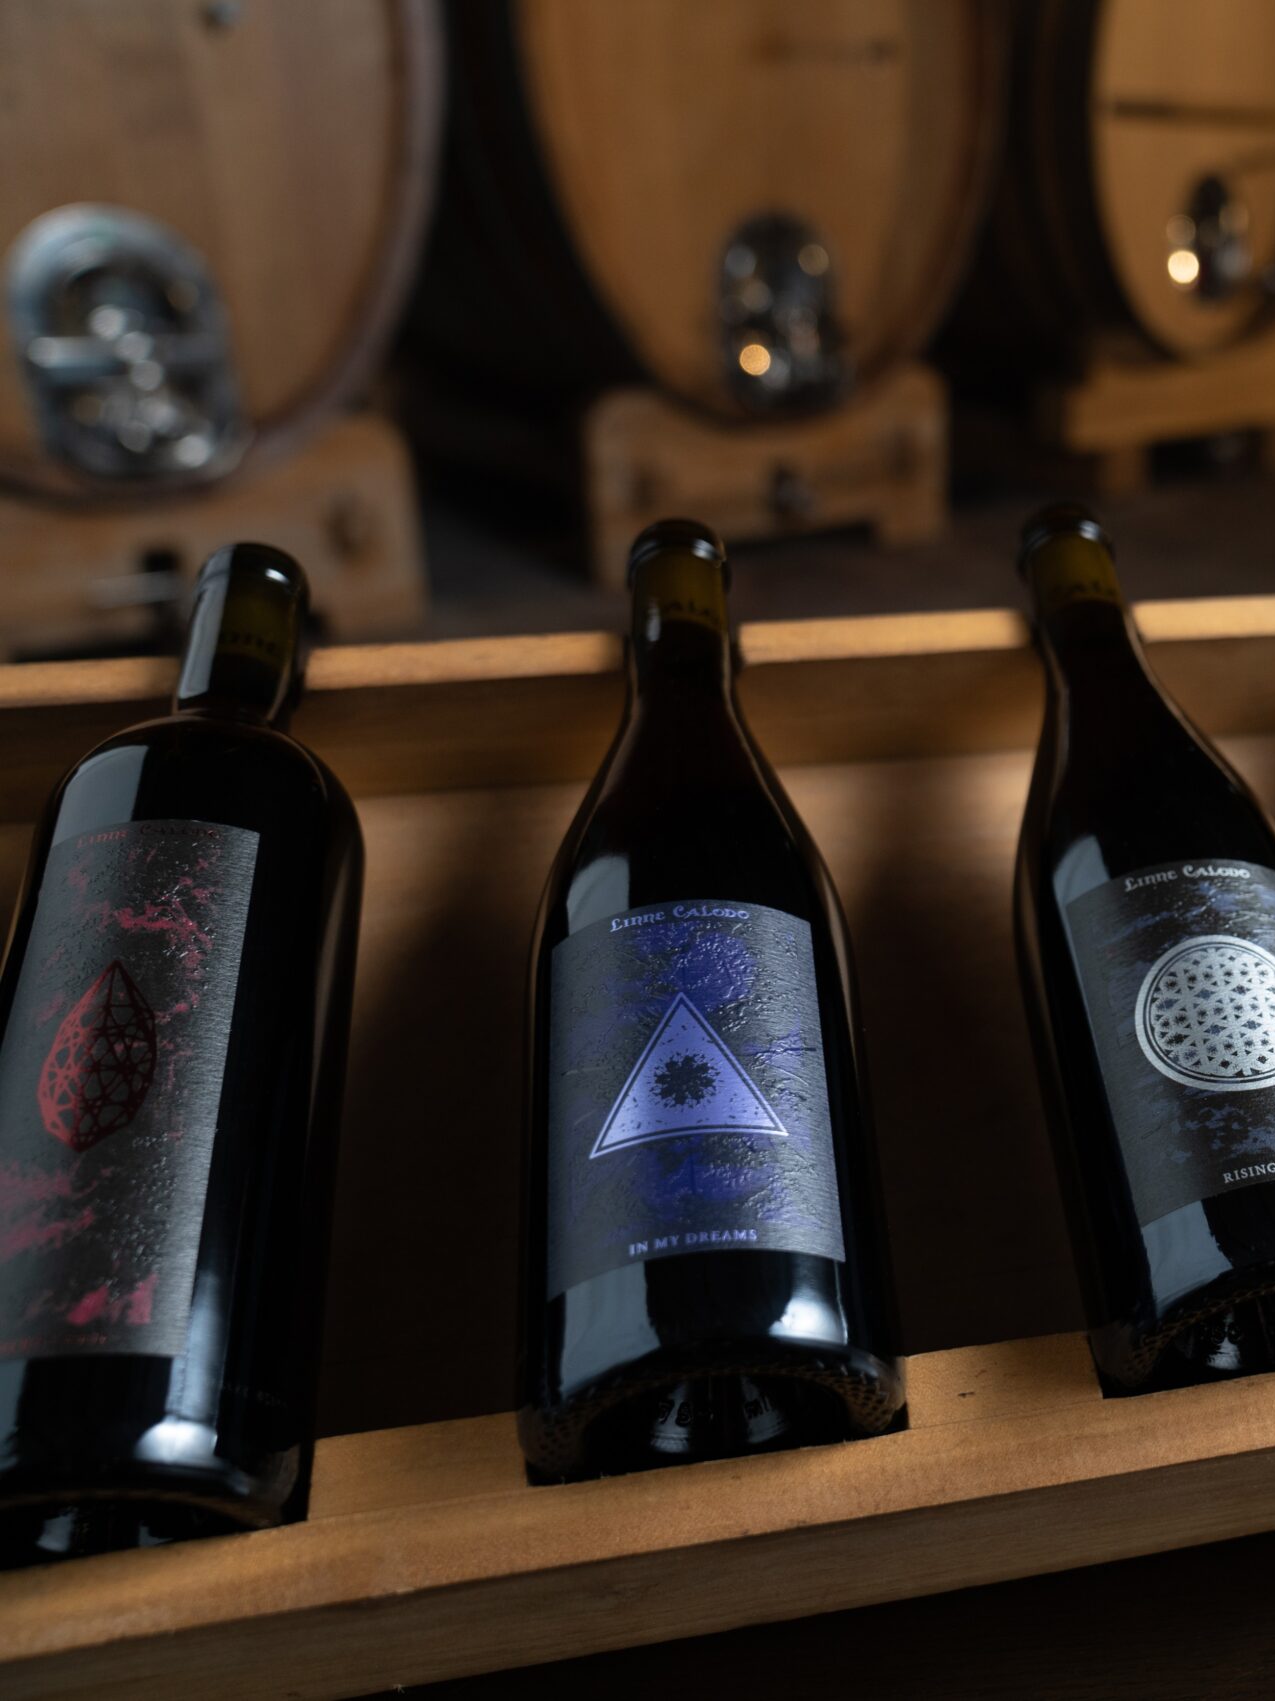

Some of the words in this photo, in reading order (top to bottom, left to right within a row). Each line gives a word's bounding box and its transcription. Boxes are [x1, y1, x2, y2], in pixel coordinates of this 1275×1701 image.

[629, 1241, 648, 1256] IN
[654, 1235, 680, 1249] MY
[685, 1229, 758, 1244] DREAMS
